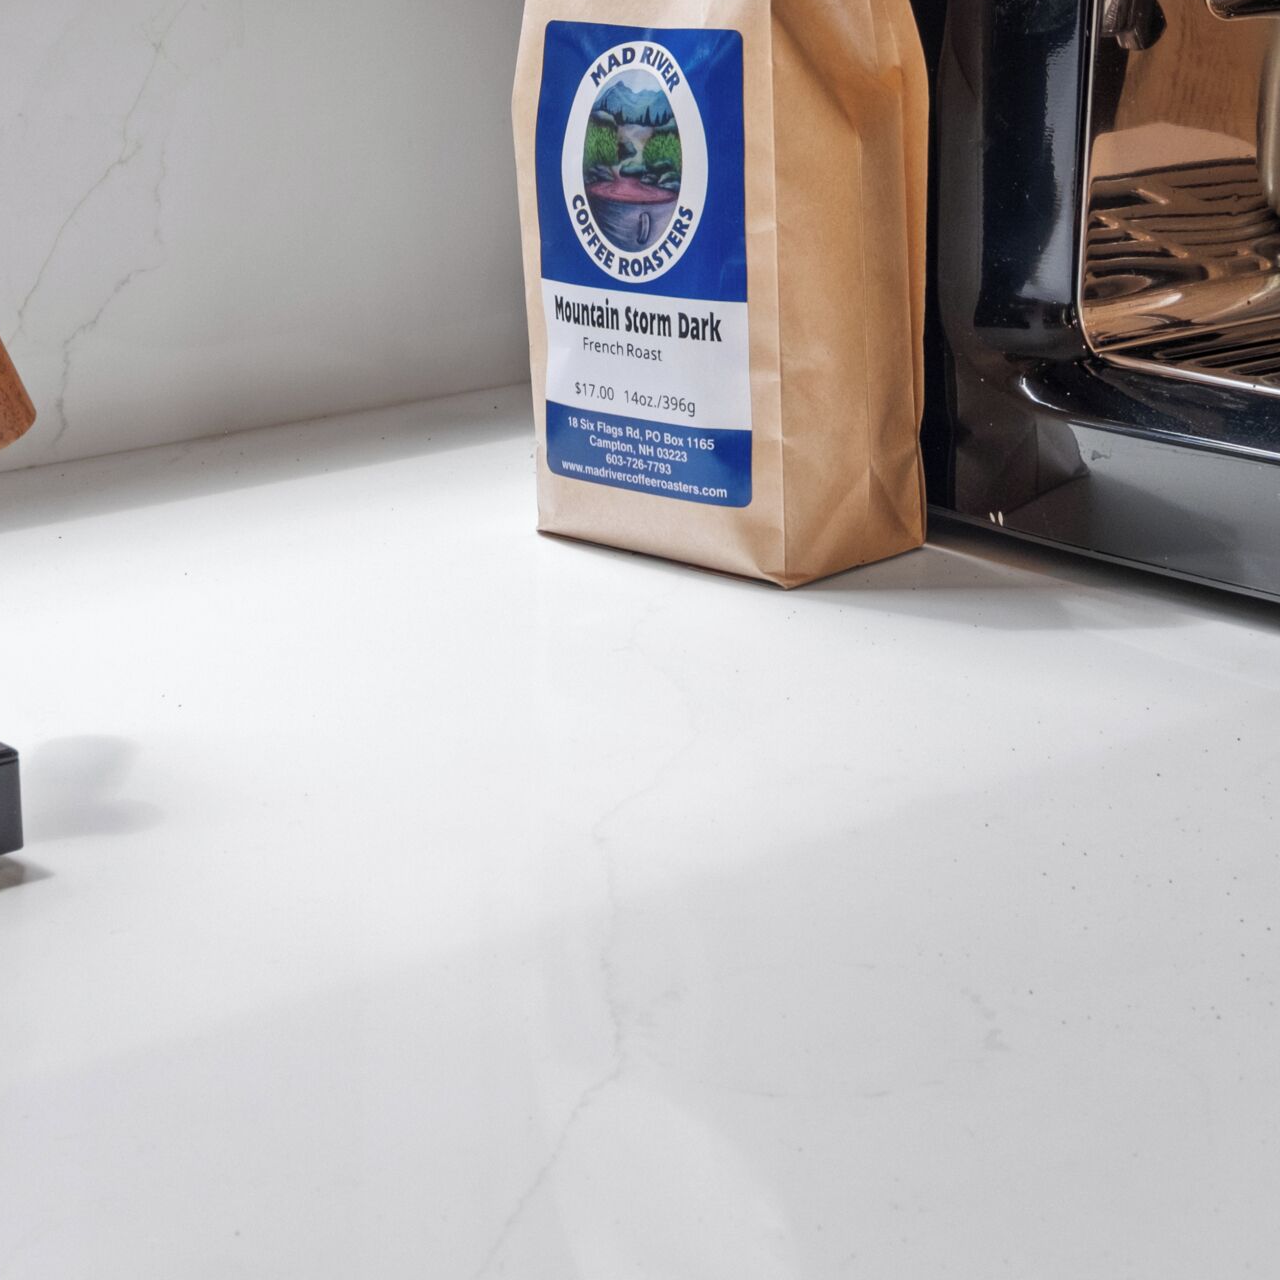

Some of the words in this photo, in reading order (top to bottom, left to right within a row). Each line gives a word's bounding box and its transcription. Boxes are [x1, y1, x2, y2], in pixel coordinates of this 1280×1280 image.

[590, 47, 636, 87] MAD
[640, 46, 680, 93] RIVER
[572, 194, 615, 269] COFFEE
[618, 206, 694, 277] ROASTERS
[555, 295, 620, 331] Mountain
[624, 306, 672, 337] Storm
[678, 312, 722, 342] Dark
[583, 337, 624, 356] French
[626, 343, 662, 361] Roast
[574, 381, 615, 401] $17.00
[624, 390, 696, 417] 14oz./396g
[568, 416, 578, 428] 18
[580, 419, 595, 431] Six
[597, 421, 623, 438] Flags
[625, 426, 643, 441] Rd,
[645, 430, 661, 442] PO
[664, 433, 684, 447] Box
[687, 437, 715, 451] 1165
[589, 435, 637, 456] Campton,
[638, 445, 654, 457] NH
[656, 448, 688, 463] 03223
[561, 460, 728, 498] www.madrivercoffeeroasters.com
[605, 453, 672, 475] 603-726-7793
